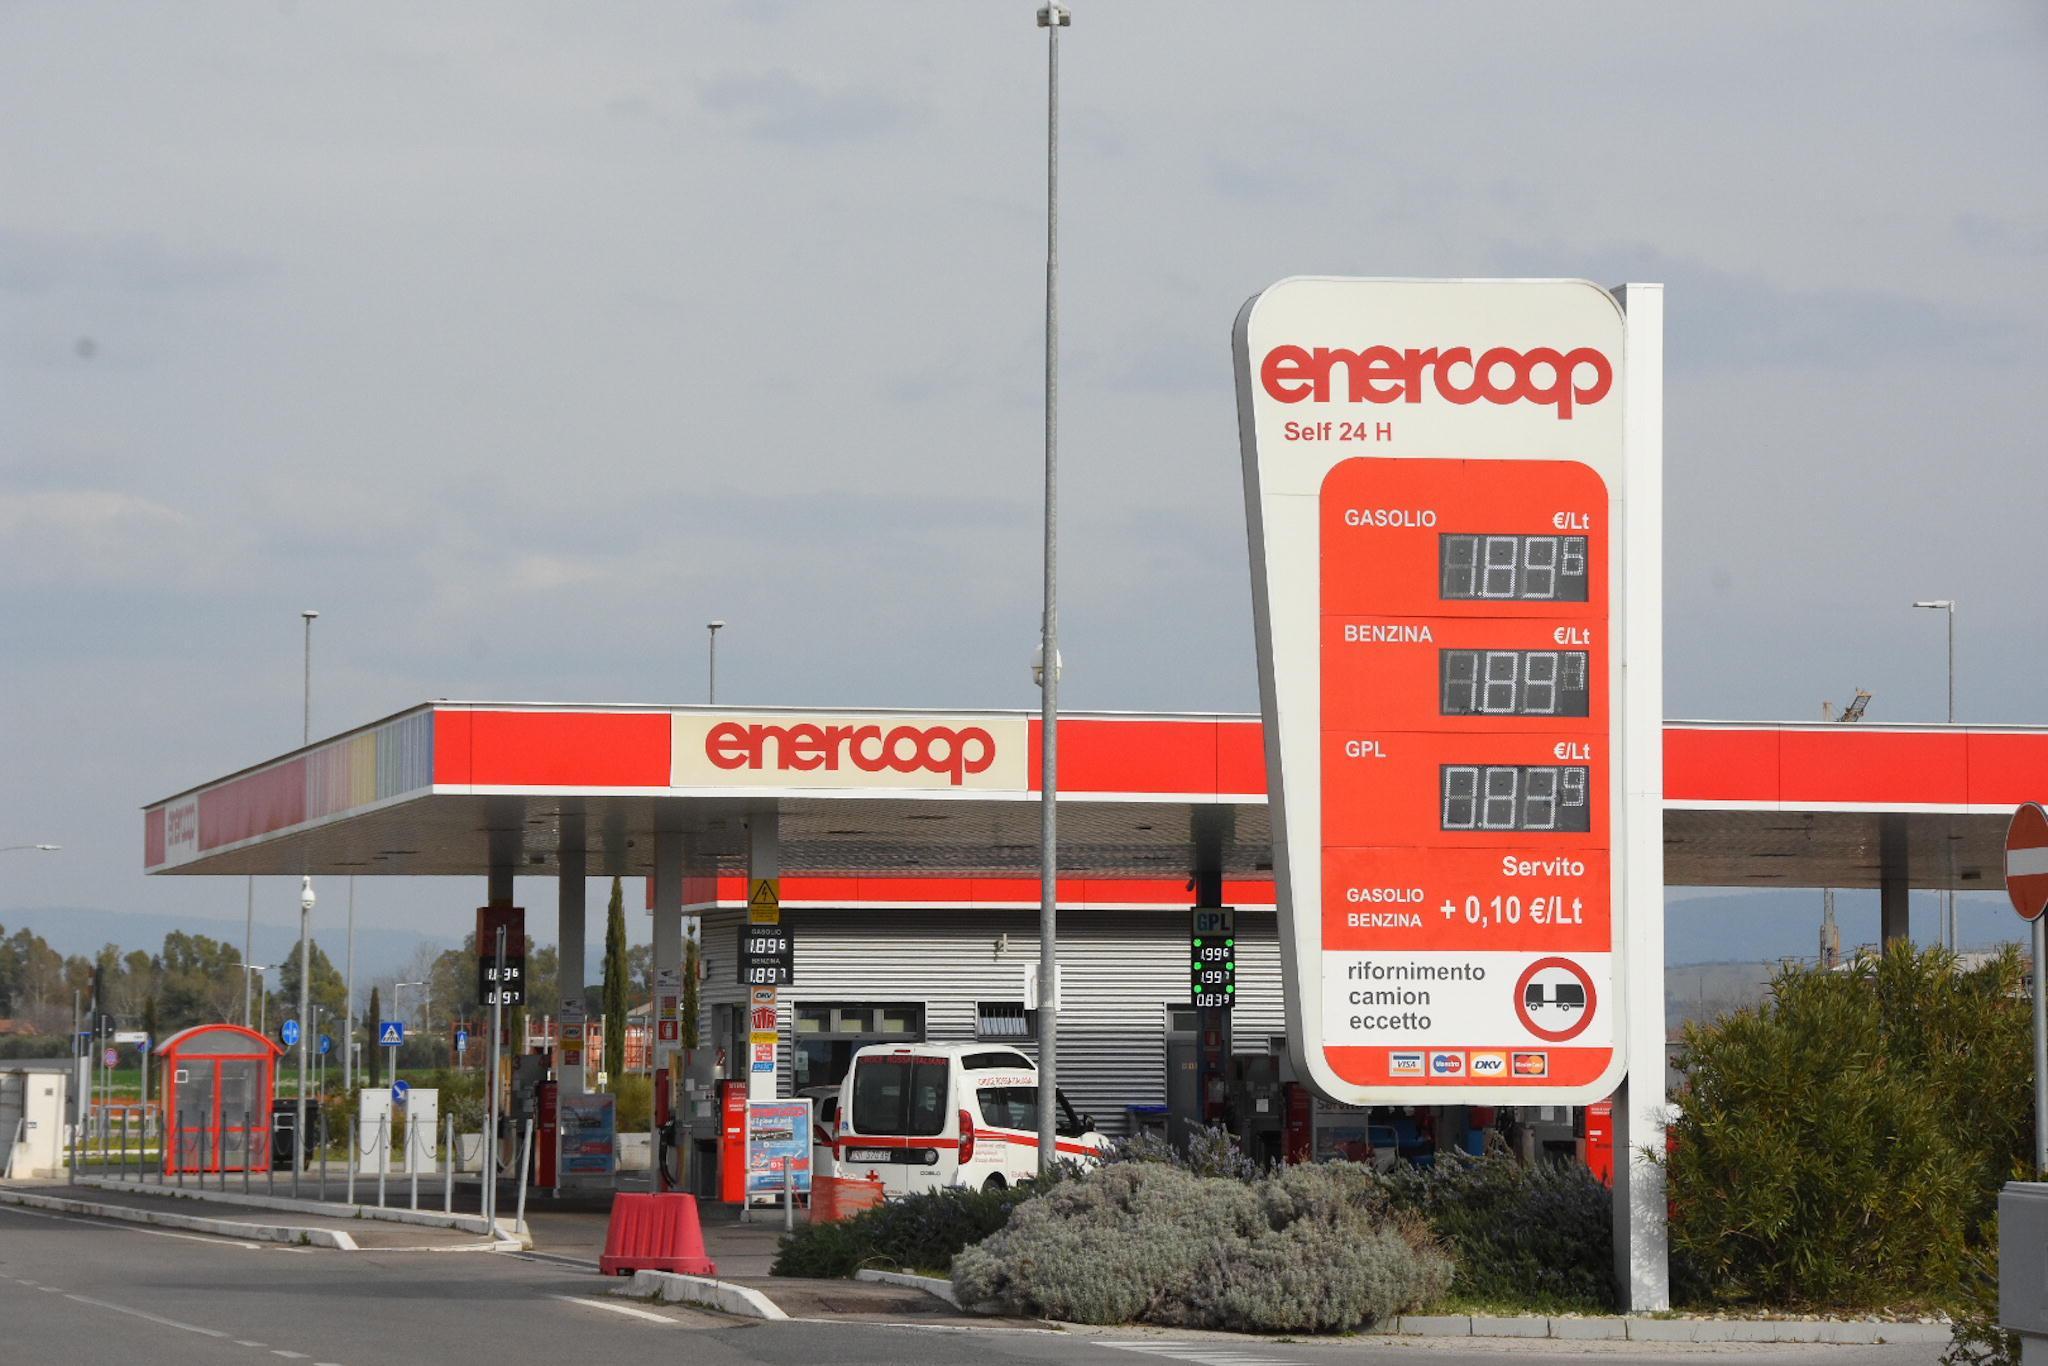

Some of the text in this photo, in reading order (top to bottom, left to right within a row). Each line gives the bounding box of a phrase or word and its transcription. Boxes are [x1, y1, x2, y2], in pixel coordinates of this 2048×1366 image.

[1260, 344, 1613, 420] enercoop
[1284, 421, 1392, 441] Self 24 H
[1344, 509, 1437, 527] GASOLIO
[1552, 511, 1590, 529] €/Lt
[1344, 625, 1433, 642] BENZINA
[1553, 627, 1590, 645] €/Lt
[705, 721, 996, 786] enercoop
[1345, 740, 1386, 758] GPL
[1553, 742, 1591, 760] €/Lt
[1502, 855, 1585, 877] Servito
[1346, 888, 1424, 903] GASOLIO
[1347, 913, 1423, 927] BENZINA
[1440, 895, 1583, 928] + 0,10 €/Lt
[1197, 912, 1230, 931] GPL
[1348, 961, 1486, 981] rifornimento
[1349, 987, 1431, 1005] camion
[1349, 1012, 1432, 1030] eccetto
[1474, 1060, 1502, 1070] DKV
